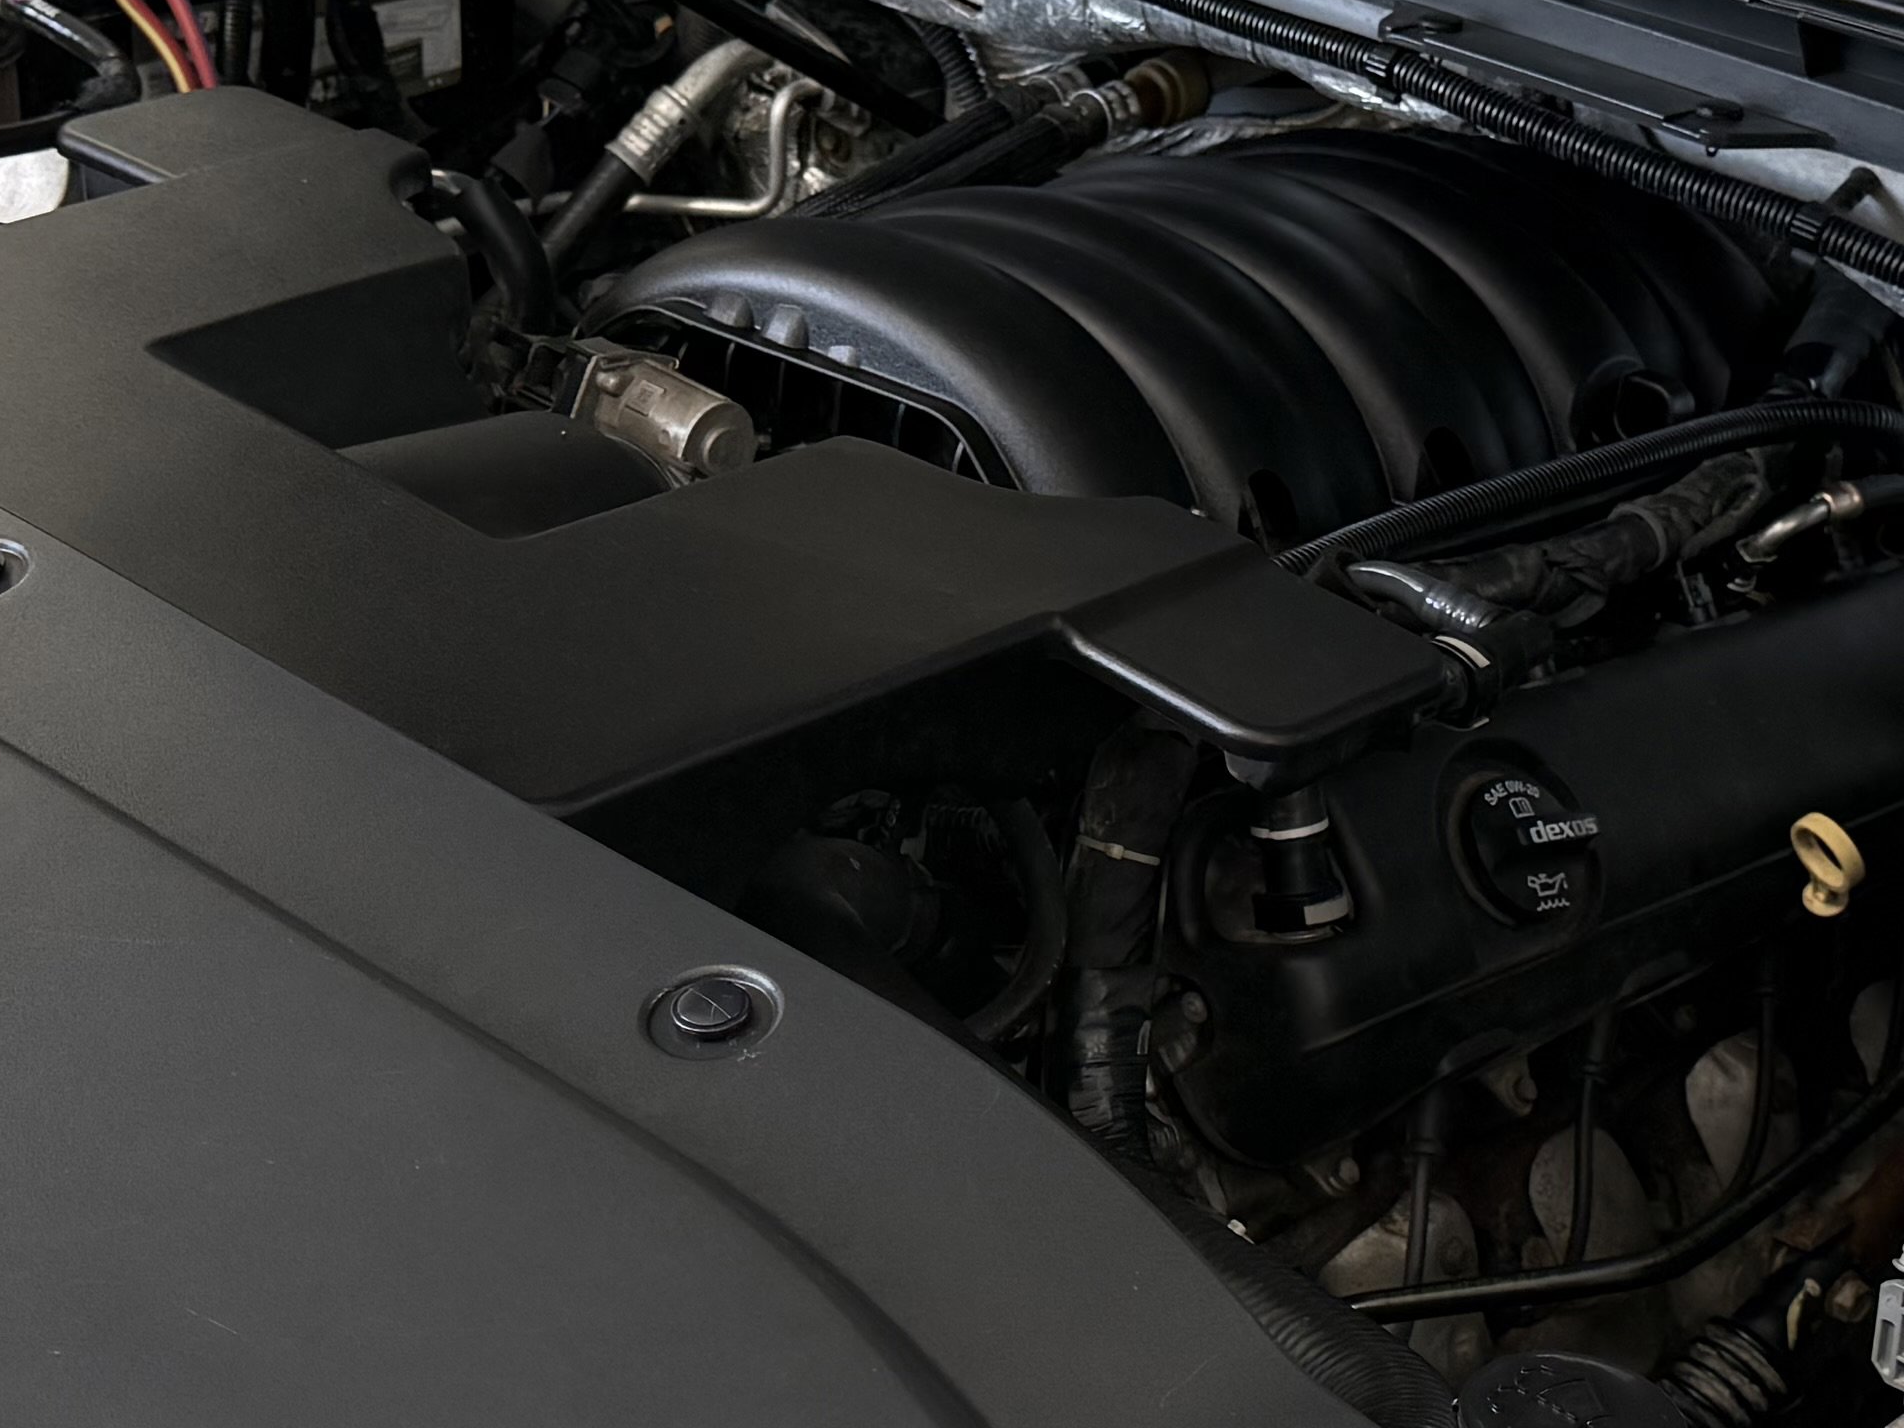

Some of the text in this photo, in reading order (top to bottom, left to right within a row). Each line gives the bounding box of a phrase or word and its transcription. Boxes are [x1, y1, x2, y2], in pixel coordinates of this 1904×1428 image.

[1484, 780, 1540, 806] SAE 0W-20
[1529, 817, 1598, 843] dexos
